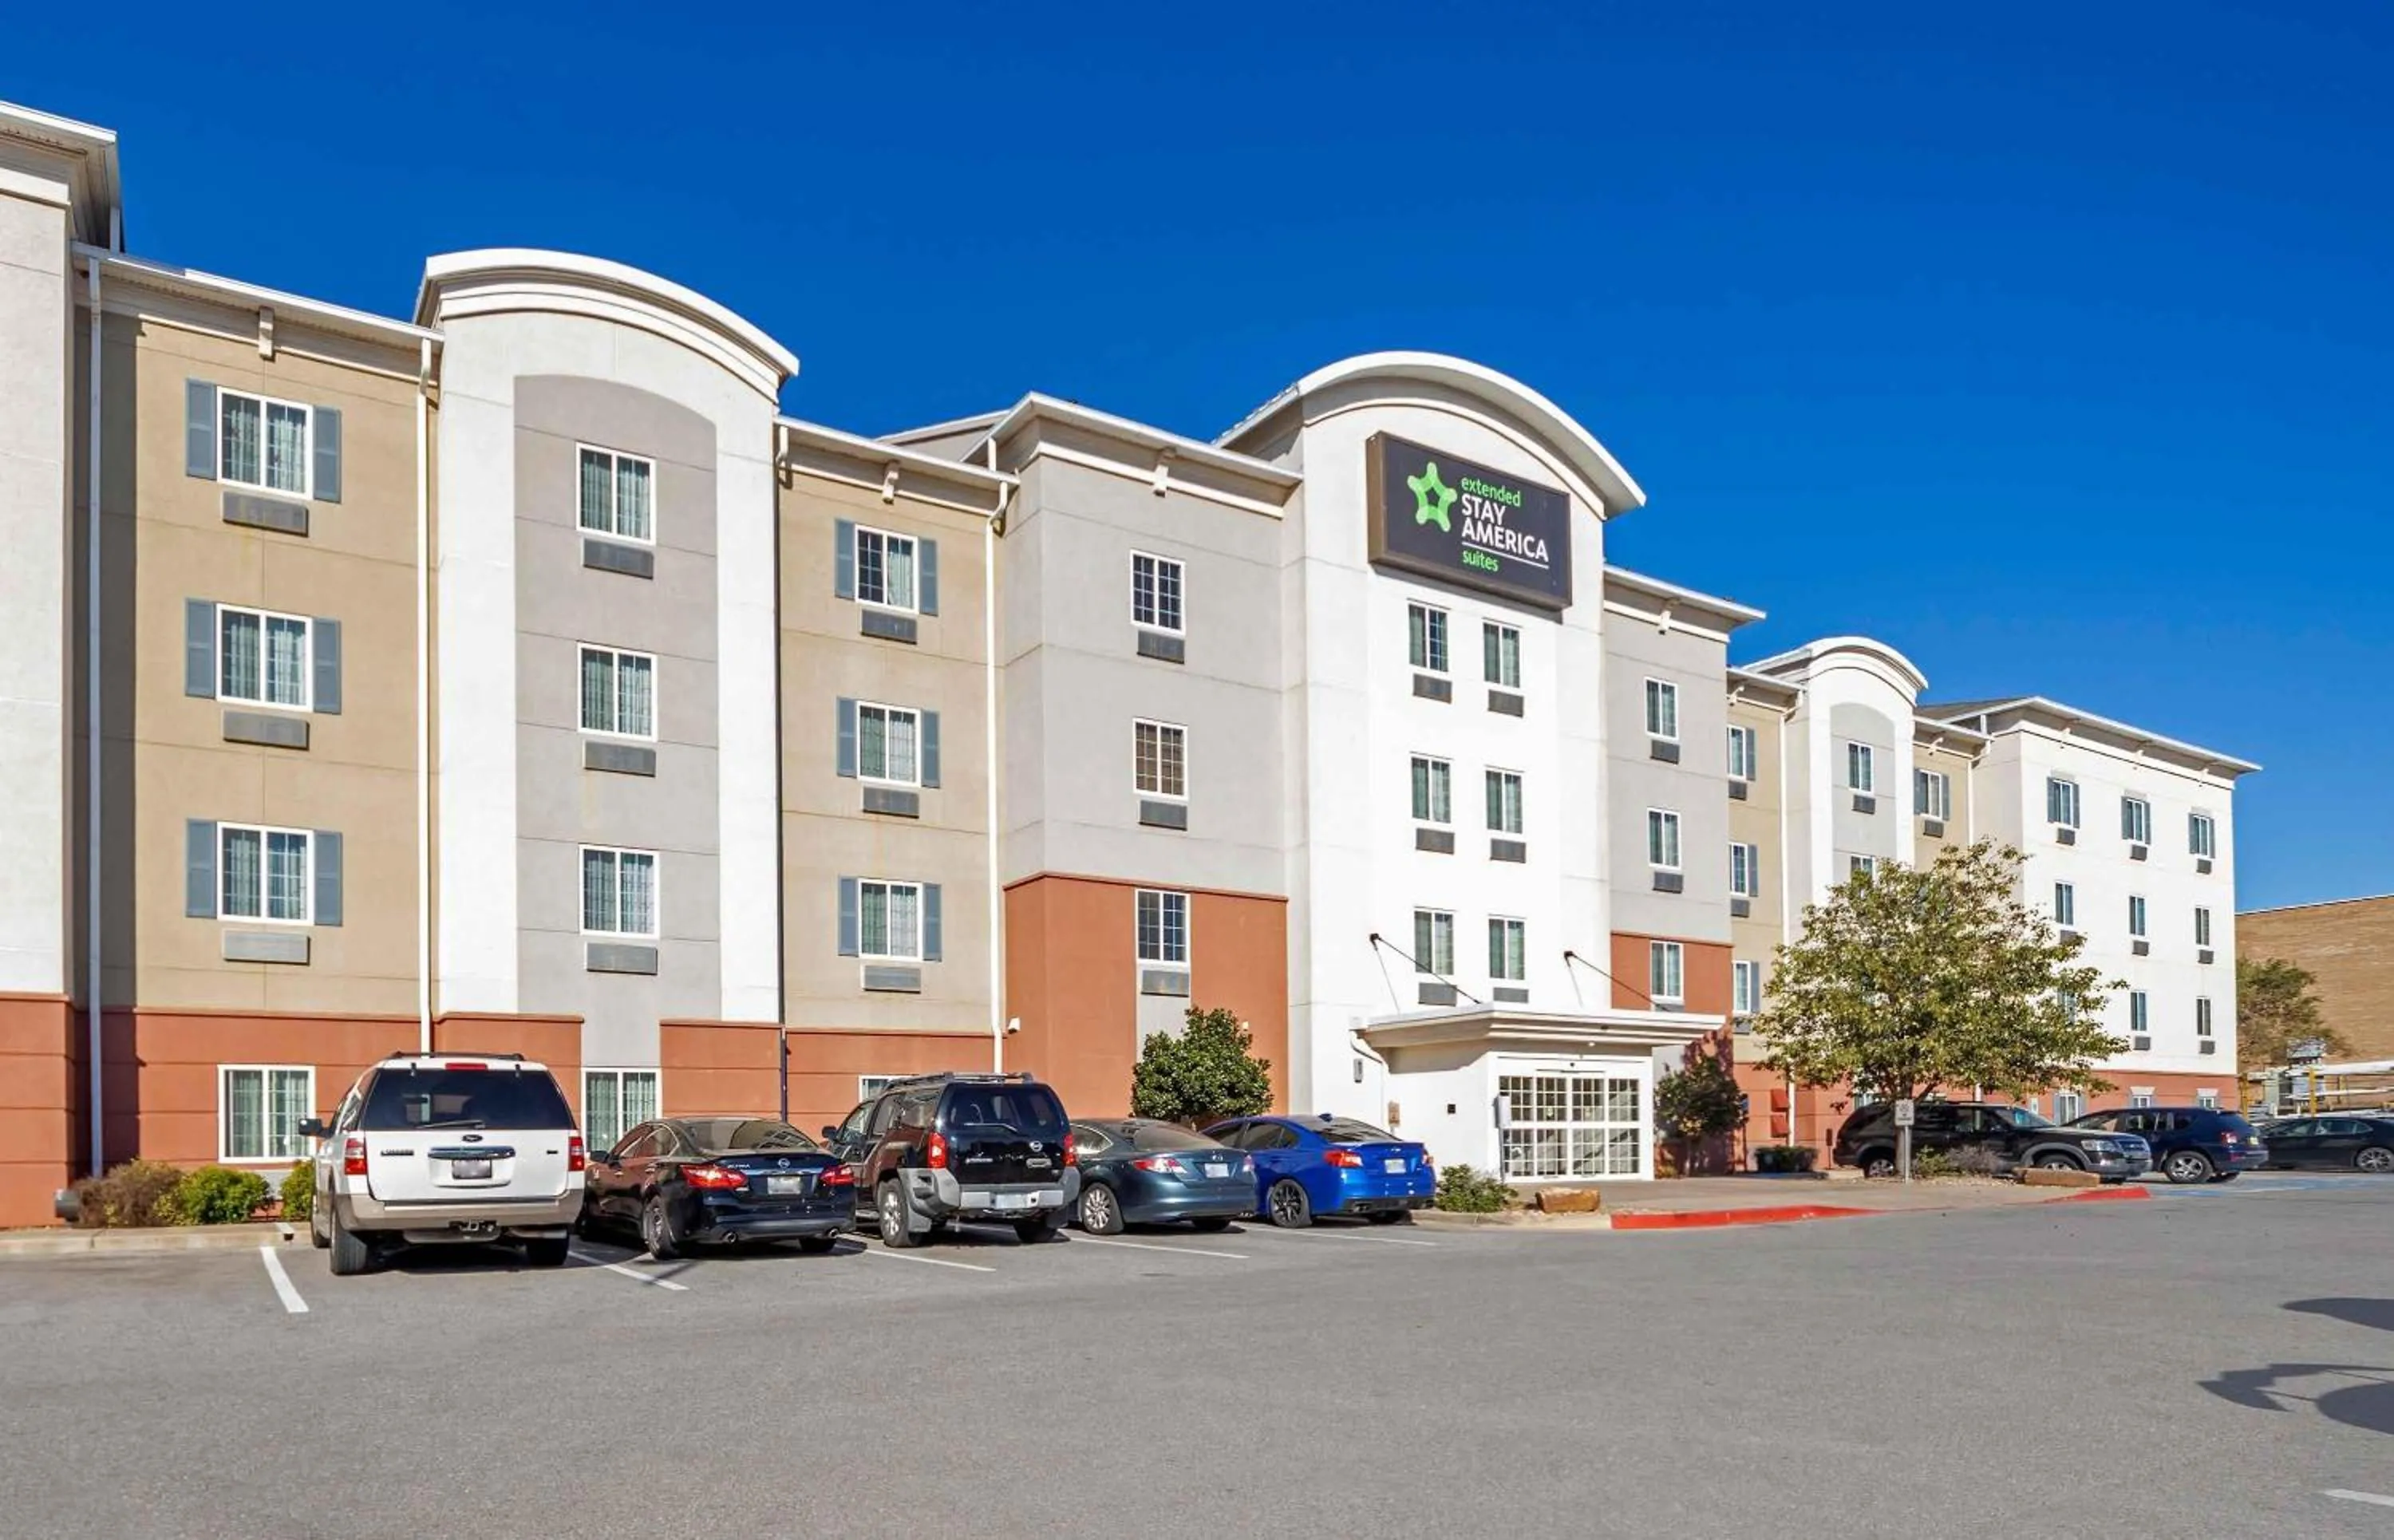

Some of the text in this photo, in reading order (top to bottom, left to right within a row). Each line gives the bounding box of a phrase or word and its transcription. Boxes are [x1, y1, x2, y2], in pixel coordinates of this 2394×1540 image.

[1461, 477, 1520, 507] extended
[1461, 493, 1506, 525] STAY
[1461, 516, 1549, 562] AMERICA
[1463, 550, 1498, 571] suites
